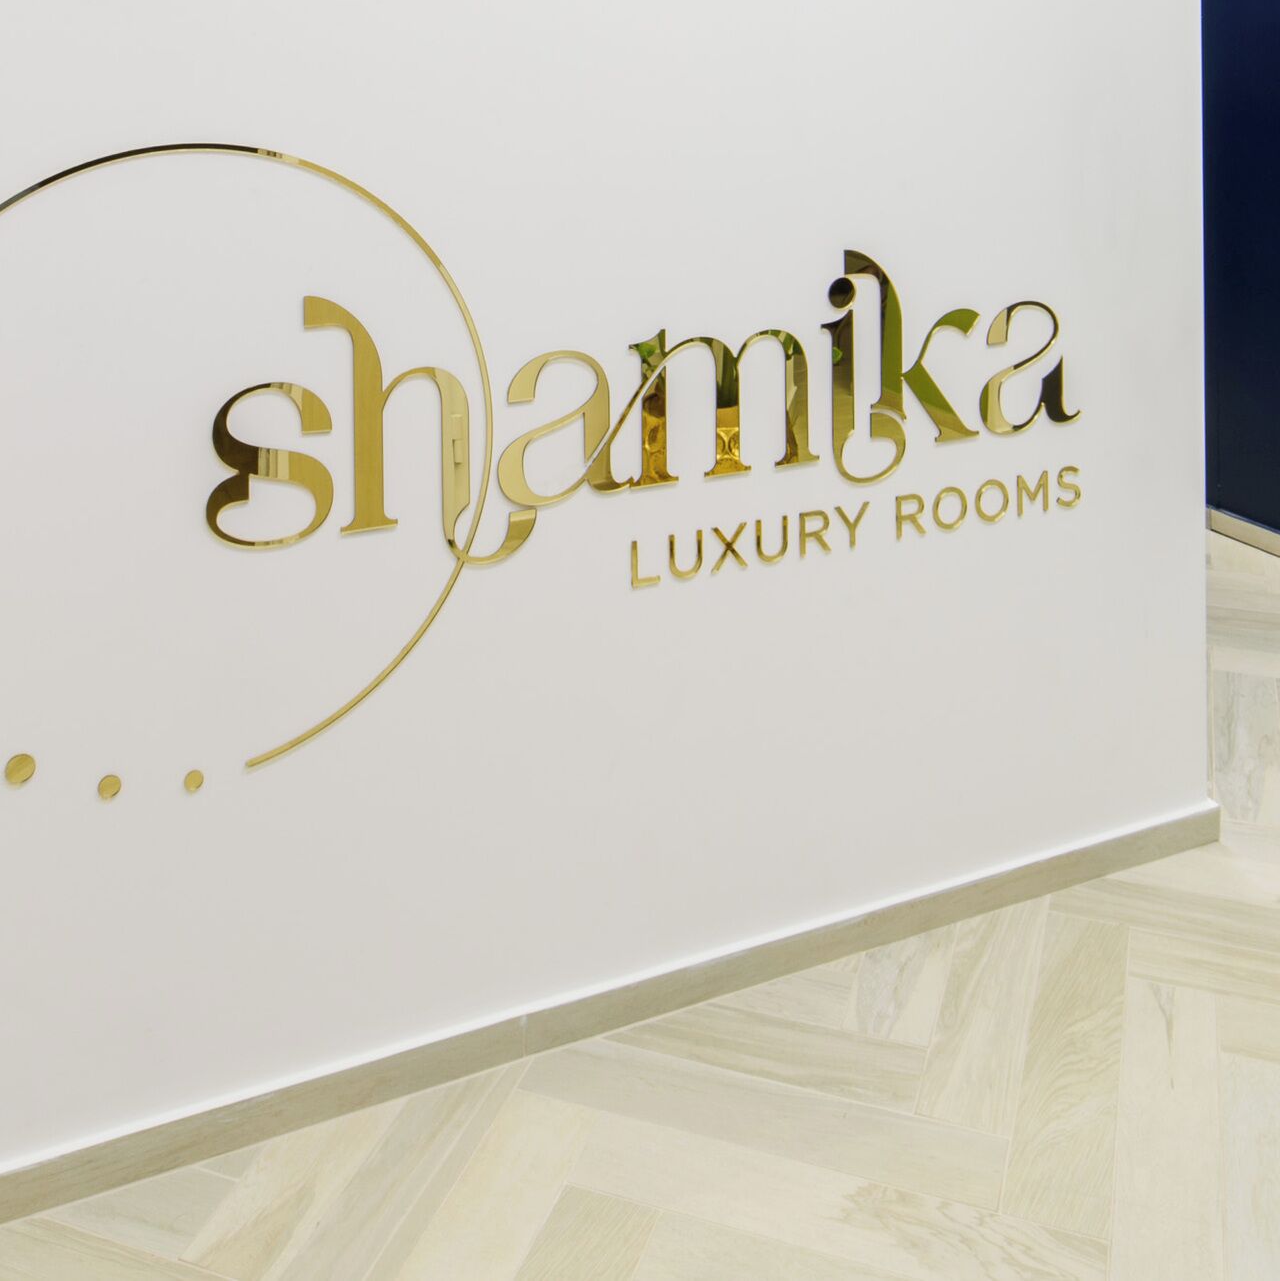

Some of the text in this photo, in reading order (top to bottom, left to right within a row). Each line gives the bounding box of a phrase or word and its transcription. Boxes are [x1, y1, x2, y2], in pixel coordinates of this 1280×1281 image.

[205, 249, 1081, 565] shamika
[630, 465, 1082, 589] LUXURY ROOMS
